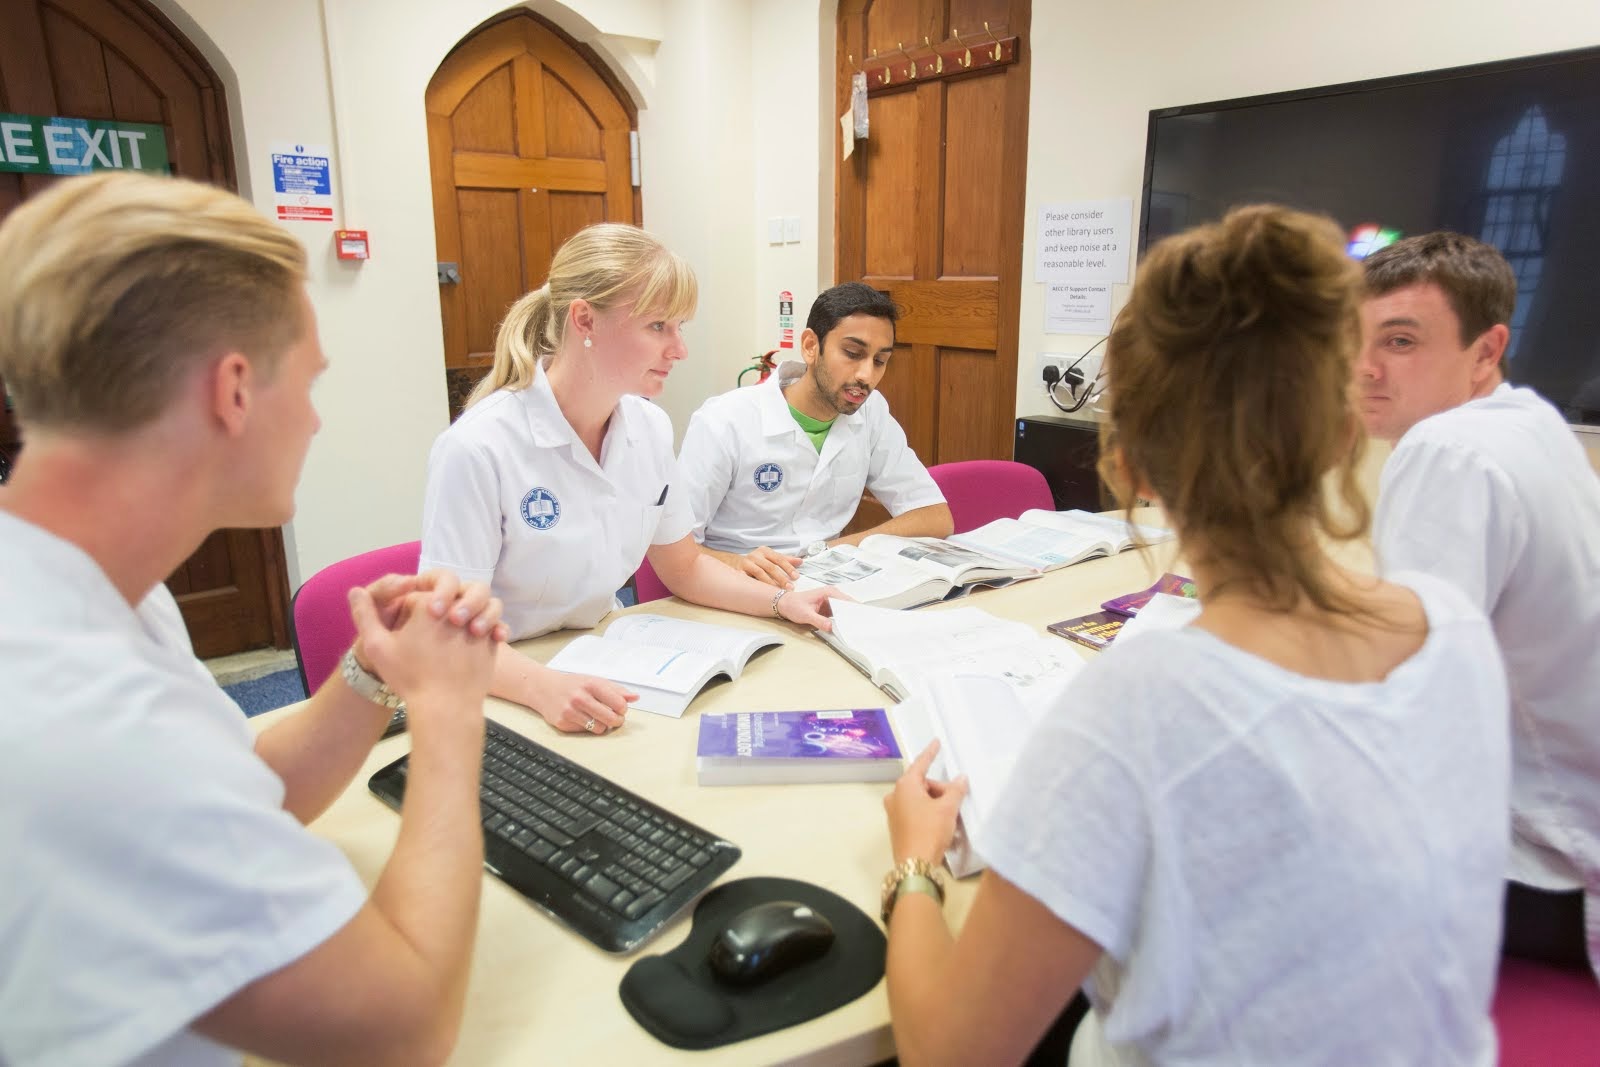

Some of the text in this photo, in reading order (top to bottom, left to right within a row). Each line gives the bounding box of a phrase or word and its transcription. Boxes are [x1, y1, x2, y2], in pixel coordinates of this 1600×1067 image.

[0, 122, 147, 169] E EXIT
[273, 154, 328, 167] Fire action
[1045, 210, 1104, 221] Please consider
[1045, 227, 1114, 237] other library users
[1044, 244, 1058, 252] and
[1060, 243, 1078, 253] keep
[1079, 243, 1100, 252] noise
[1102, 243, 1110, 251] at
[1043, 258, 1107, 268] reasonable level.
